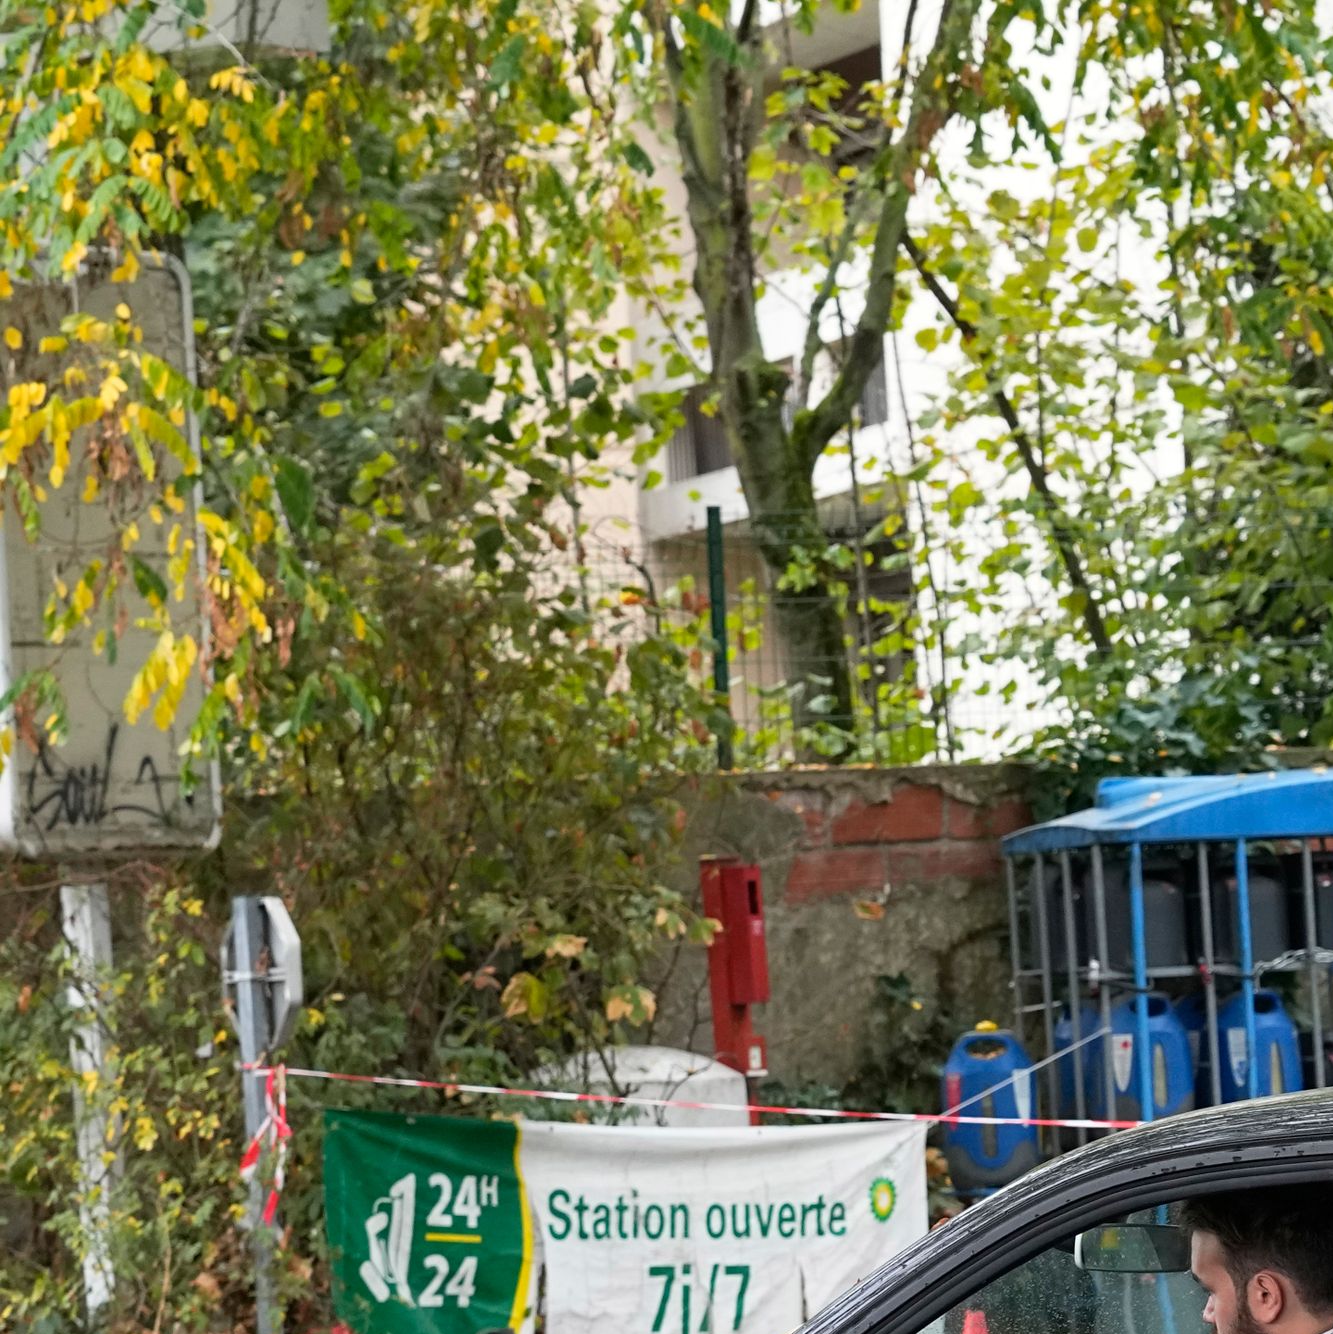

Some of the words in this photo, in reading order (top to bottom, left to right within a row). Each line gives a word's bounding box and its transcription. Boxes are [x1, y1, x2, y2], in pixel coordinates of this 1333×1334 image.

[549, 1189, 690, 1240] Station
[706, 1194, 847, 1239] ouverte
[418, 1254, 478, 1308] 24
